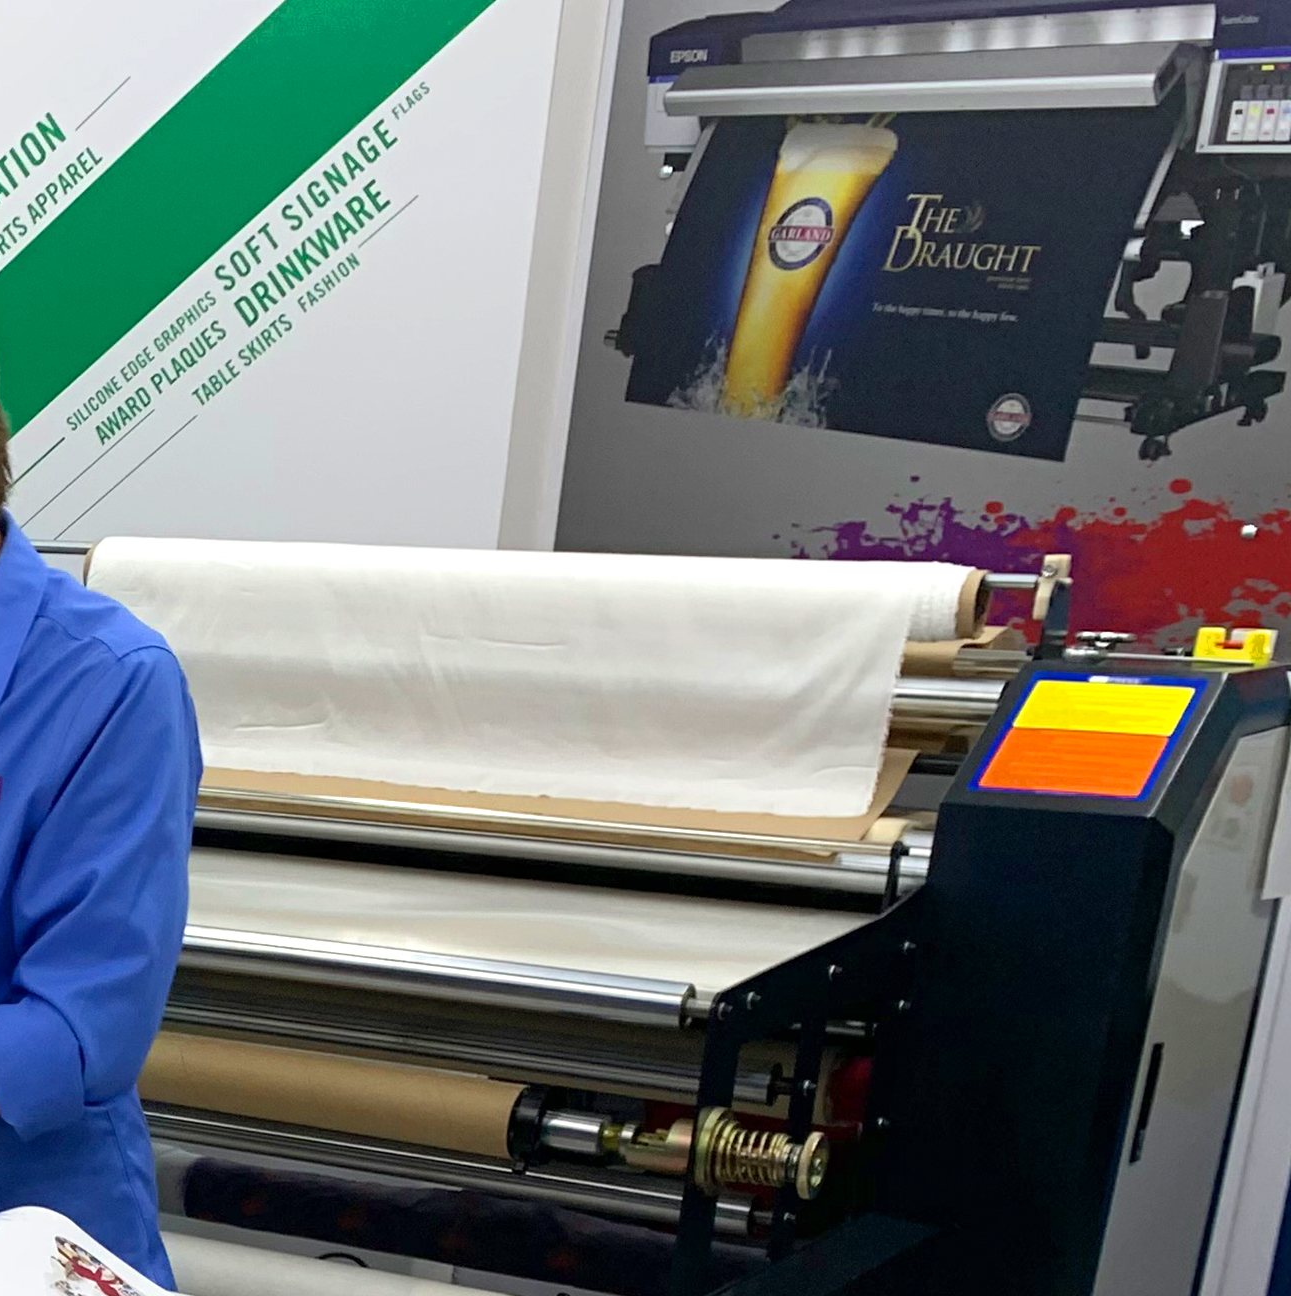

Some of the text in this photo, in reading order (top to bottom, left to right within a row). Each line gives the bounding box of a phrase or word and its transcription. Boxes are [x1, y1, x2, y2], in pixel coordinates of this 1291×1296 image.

[670, 49, 709, 63] EPSON
[391, 82, 431, 121] FLAGS
[29, 147, 104, 227] APPAREL
[214, 119, 399, 292] SOFT SIGNAGE
[905, 193, 963, 239] THE
[233, 179, 392, 329] DRINKWARE
[770, 226, 834, 243] GARLAND
[882, 226, 1042, 274] DRAUGHT
[296, 253, 361, 314] FASHION
[65, 291, 217, 432] SILICONE EDGE GRAPHICS
[93, 321, 228, 446] AWARD PLAQUES
[191, 314, 294, 407] TABLE SKIRTS
